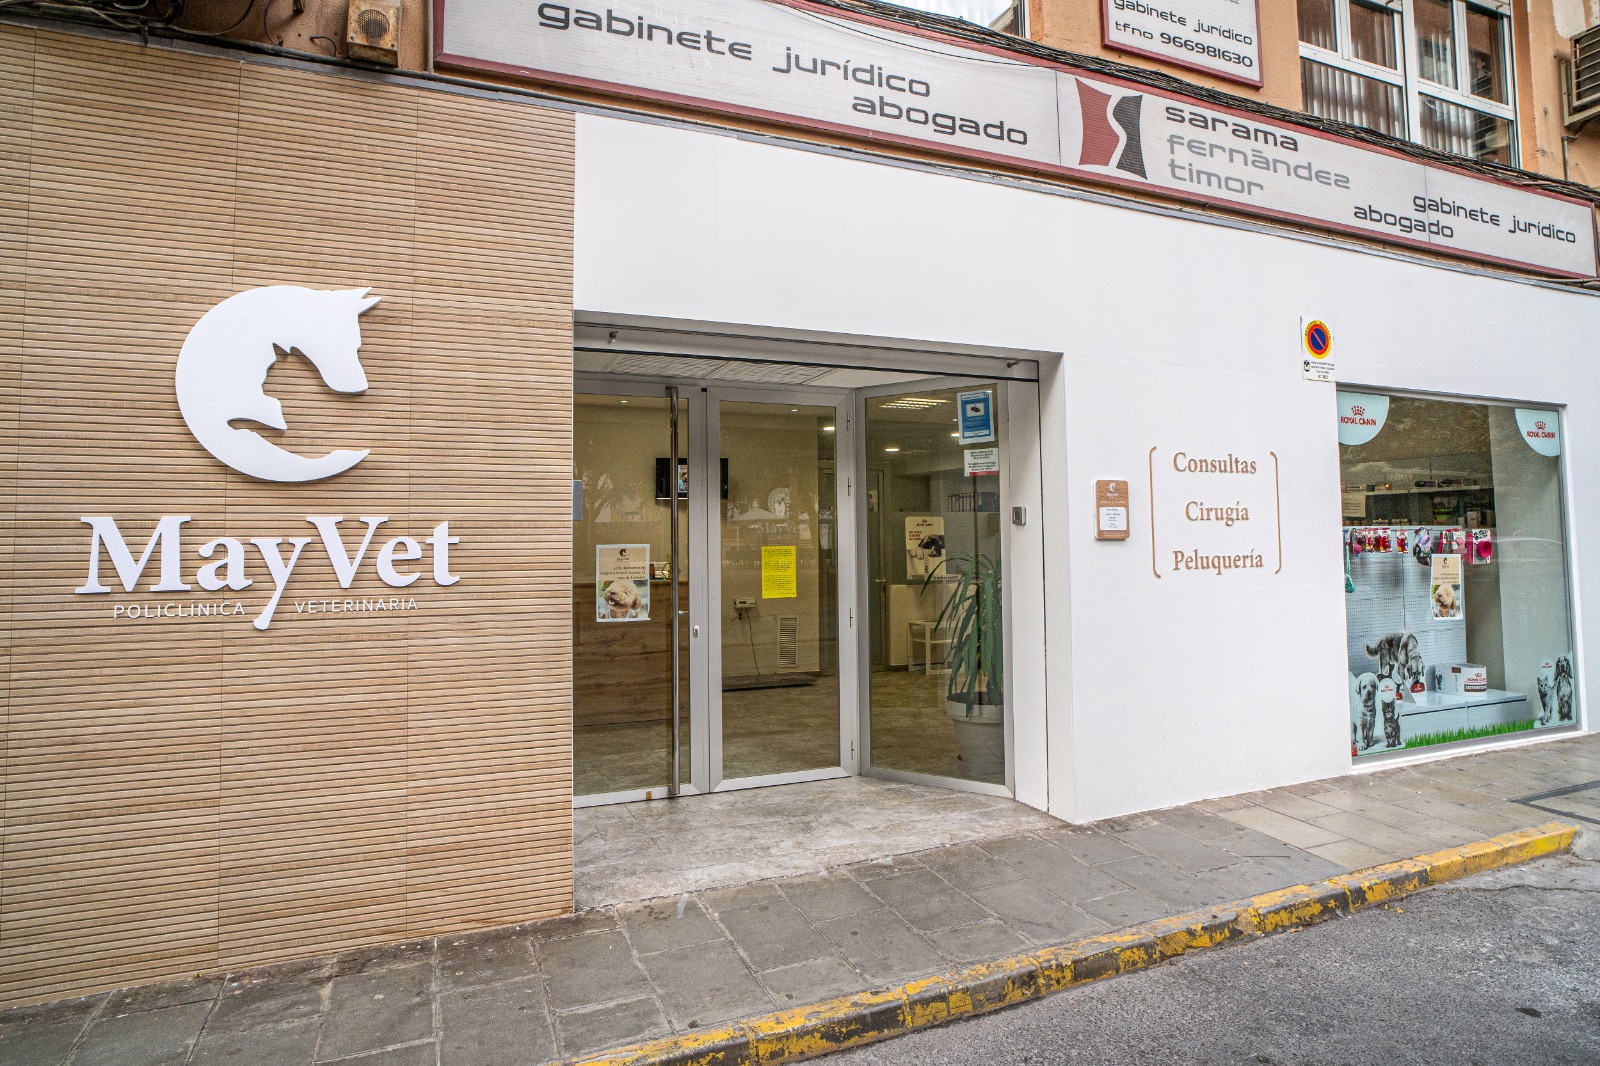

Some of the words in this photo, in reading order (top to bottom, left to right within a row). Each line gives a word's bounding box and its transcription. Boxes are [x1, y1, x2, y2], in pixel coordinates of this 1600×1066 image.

[1114, 0, 1187, 27] gabinete
[1193, 19, 1253, 46] jurídico
[1115, 20, 1154, 40] tfno
[1160, 32, 1253, 68] 966981630
[537, 2, 752, 61] gabinete
[772, 46, 931, 98] jurídico
[851, 95, 1028, 146] abogado
[1165, 106, 1299, 152] sarama
[1168, 158, 1264, 196] timor
[1353, 204, 1454, 239] abogado
[1412, 195, 1501, 227] gabinete
[1508, 215, 1576, 244] jurídico
[1340, 416, 1358, 425] ROYAL
[1358, 417, 1377, 427] CANIN
[1173, 451, 1257, 475] Consultas
[1185, 500, 1250, 527] Cirugía
[74, 514, 462, 632] MayVet
[1172, 547, 1264, 576] Peluquería
[113, 600, 246, 619] POLICLÍNICA
[294, 598, 418, 615] VETERINARIA
